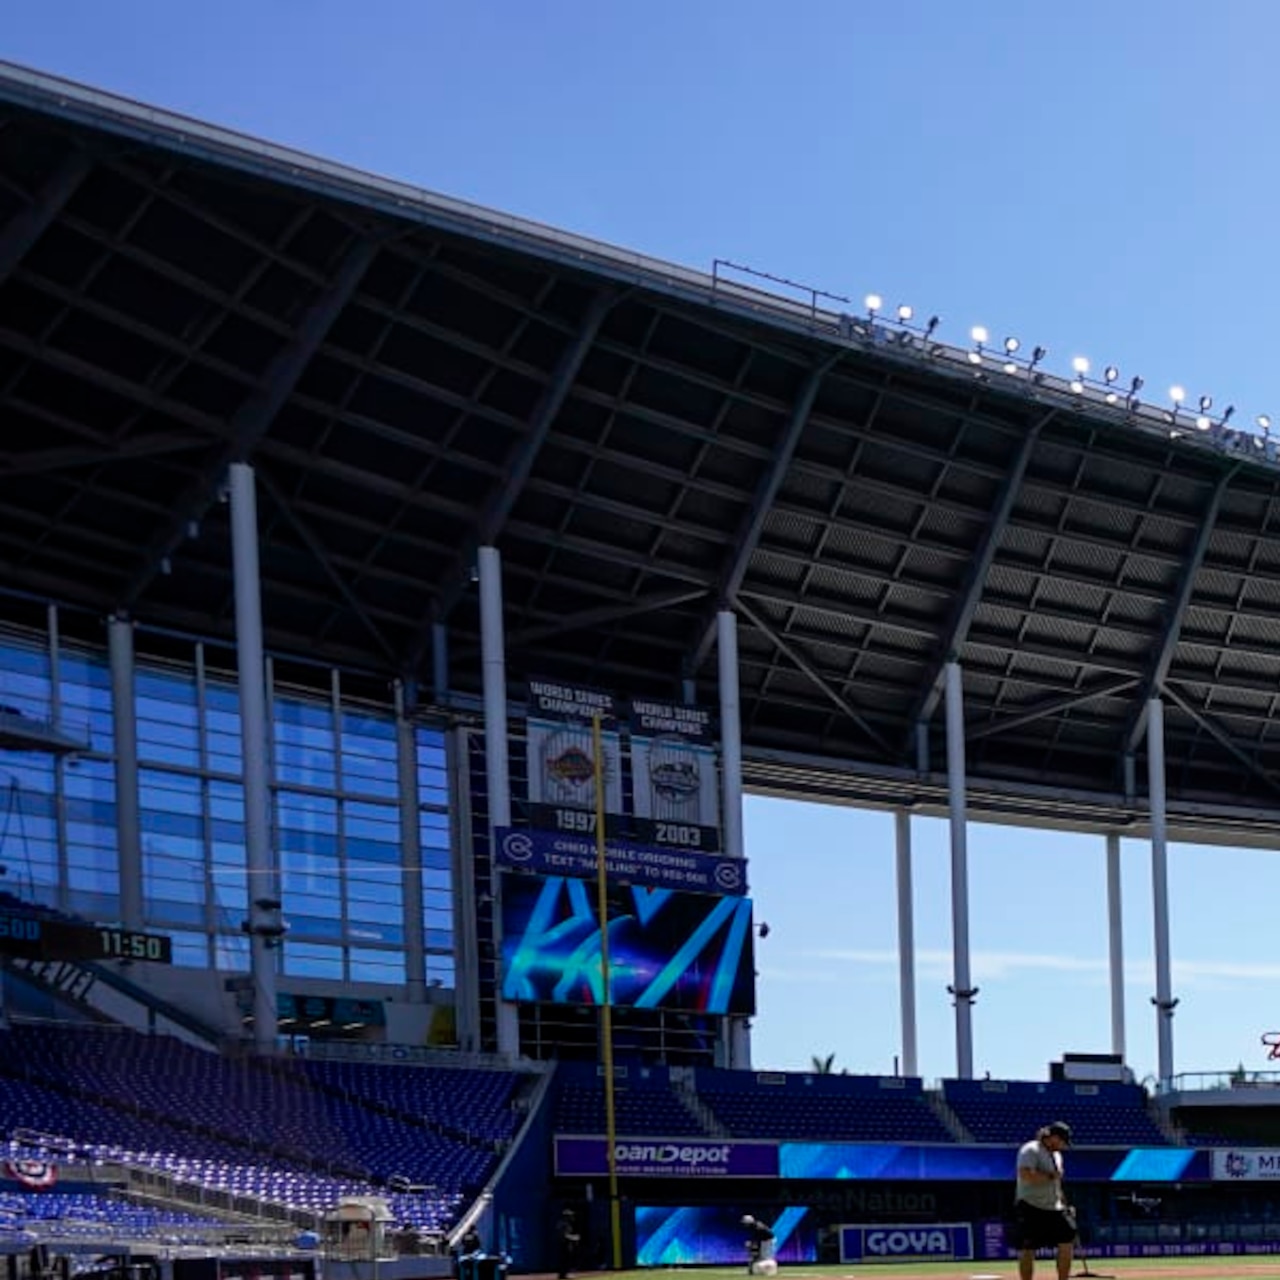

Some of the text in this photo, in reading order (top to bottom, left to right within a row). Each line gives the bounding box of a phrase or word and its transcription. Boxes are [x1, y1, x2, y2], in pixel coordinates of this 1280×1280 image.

[529, 681, 614, 708] WORLD SERIES
[632, 700, 674, 718] WORLD
[556, 809, 598, 832] 1997
[655, 823, 701, 846] 2003
[543, 853, 573, 867] TEXT
[100, 930, 162, 960] 11:50
[866, 1230, 949, 1255] GOYA
